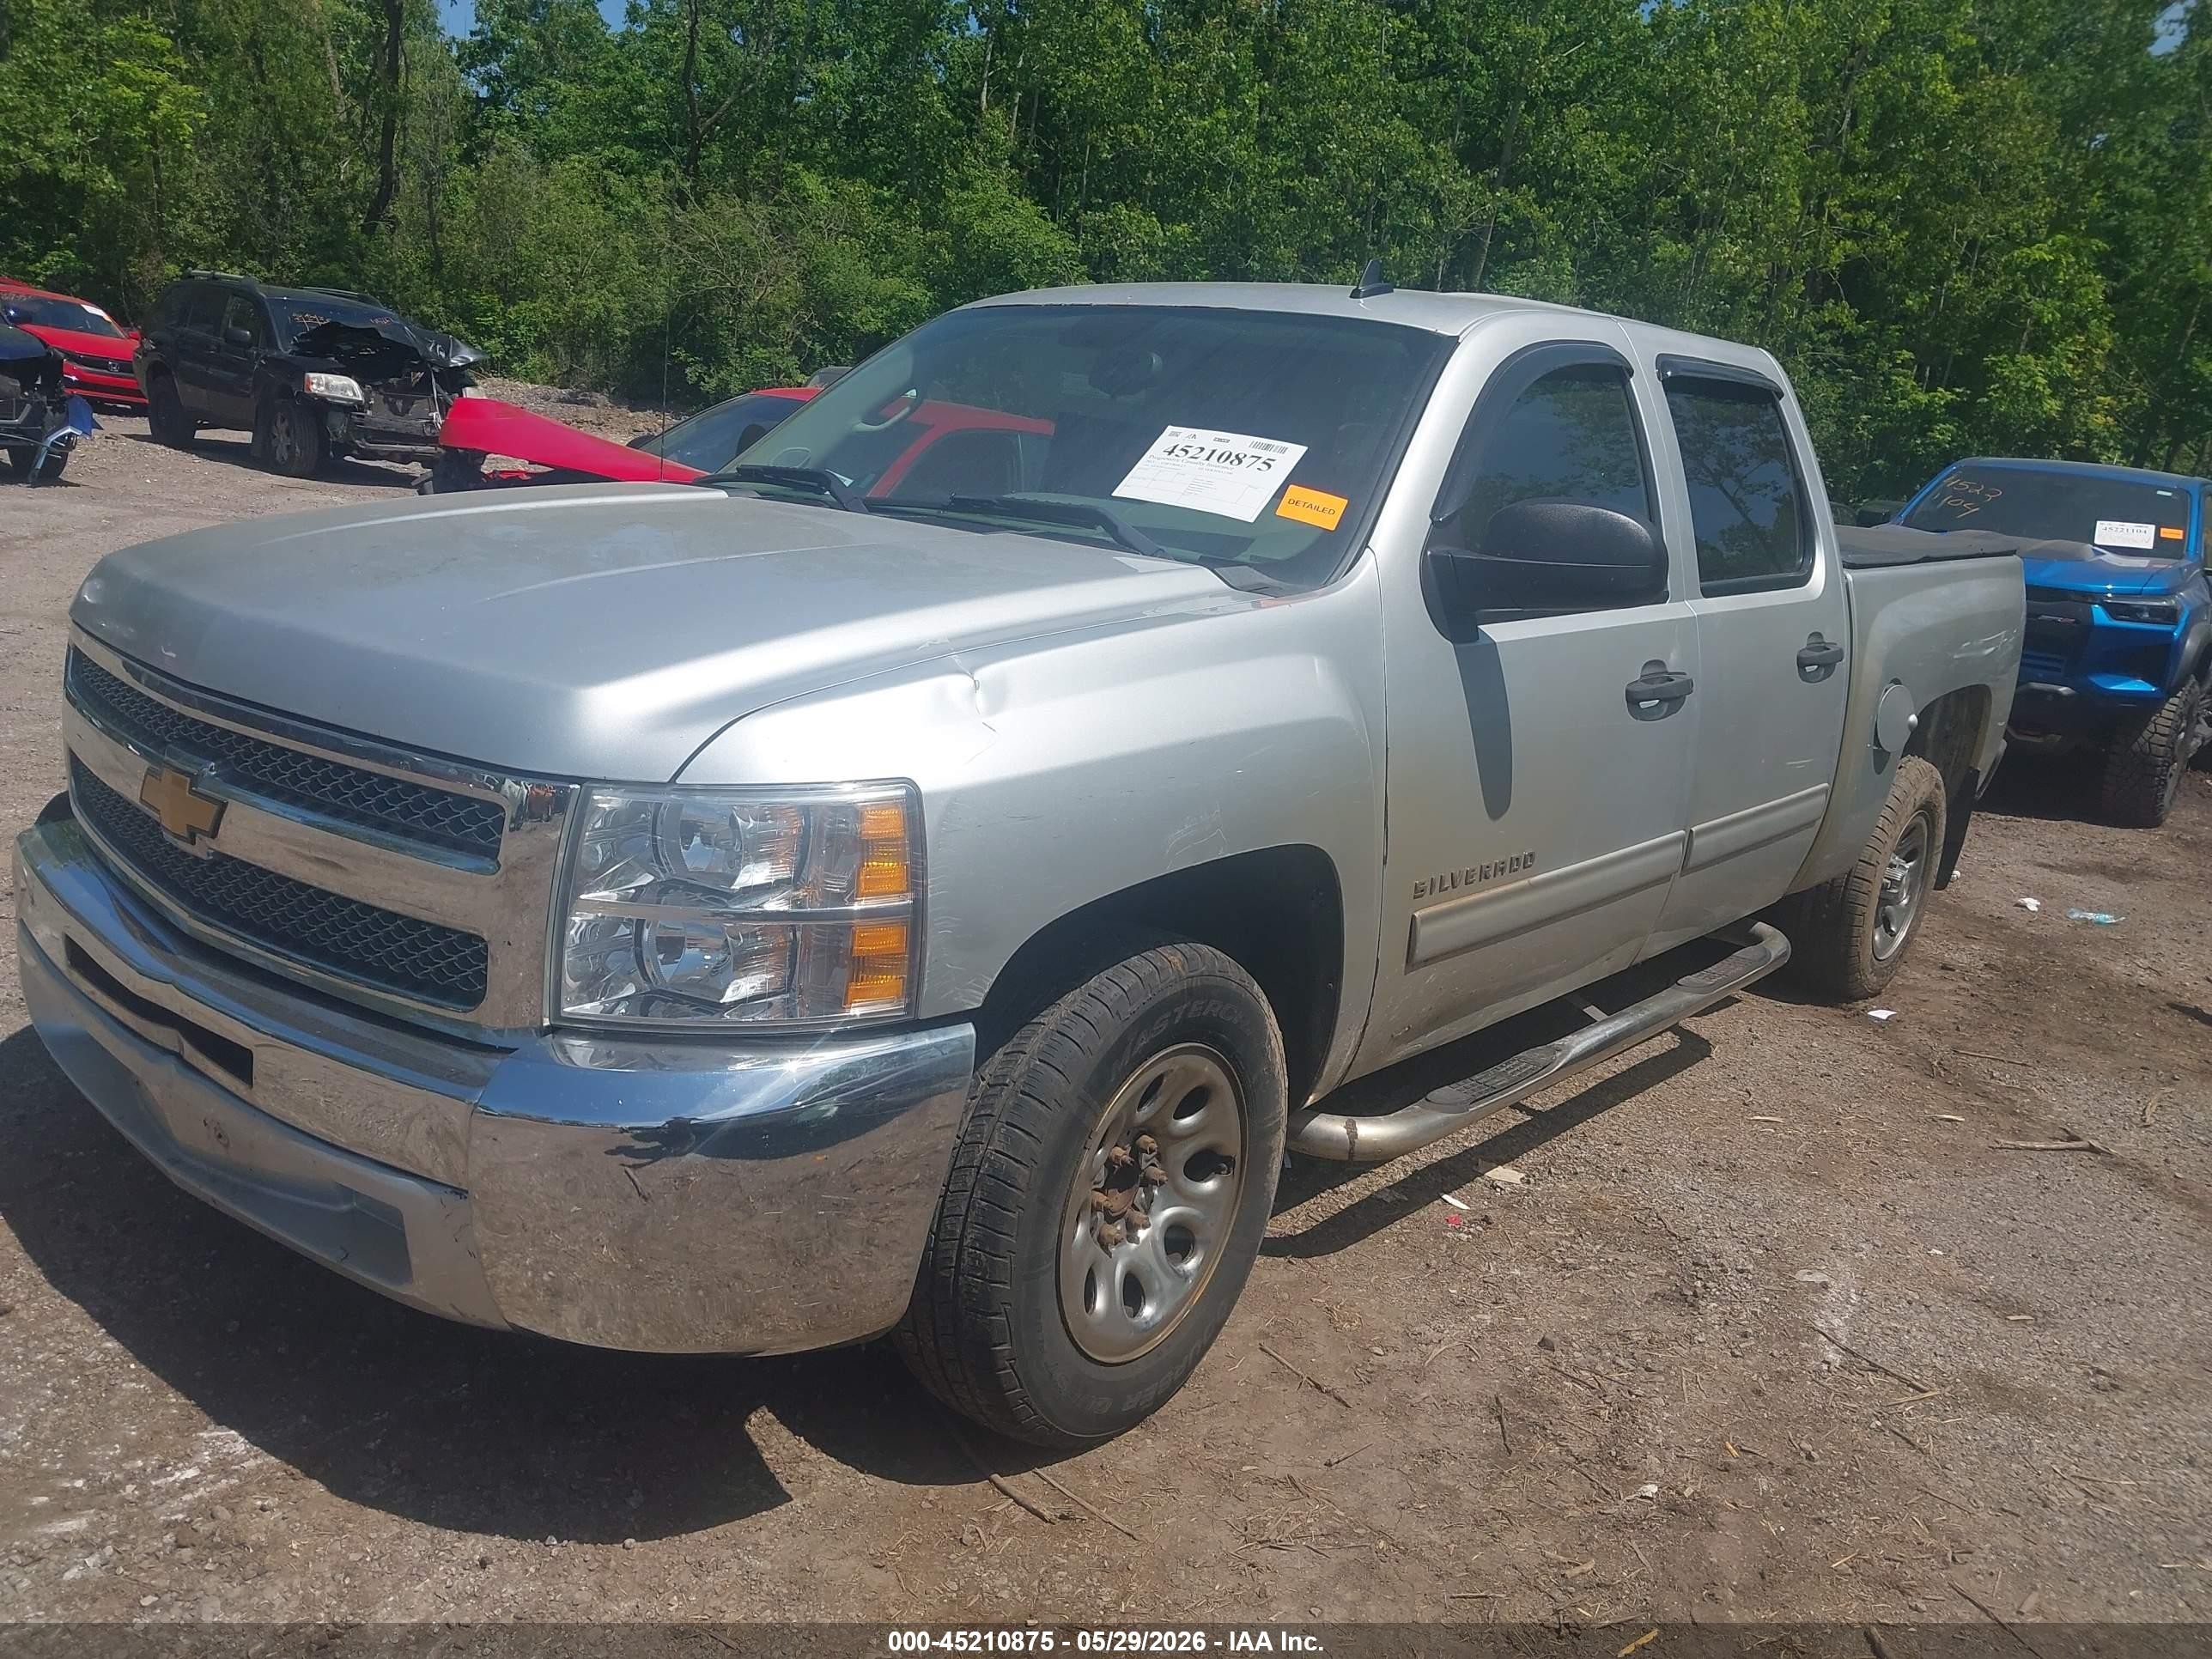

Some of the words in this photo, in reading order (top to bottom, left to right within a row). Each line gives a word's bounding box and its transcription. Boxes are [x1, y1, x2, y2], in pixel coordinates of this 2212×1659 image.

[1163, 442, 1277, 472] 45210875
[1287, 497, 1336, 517] DETAILED
[1413, 850, 1536, 900] SILVERADO
